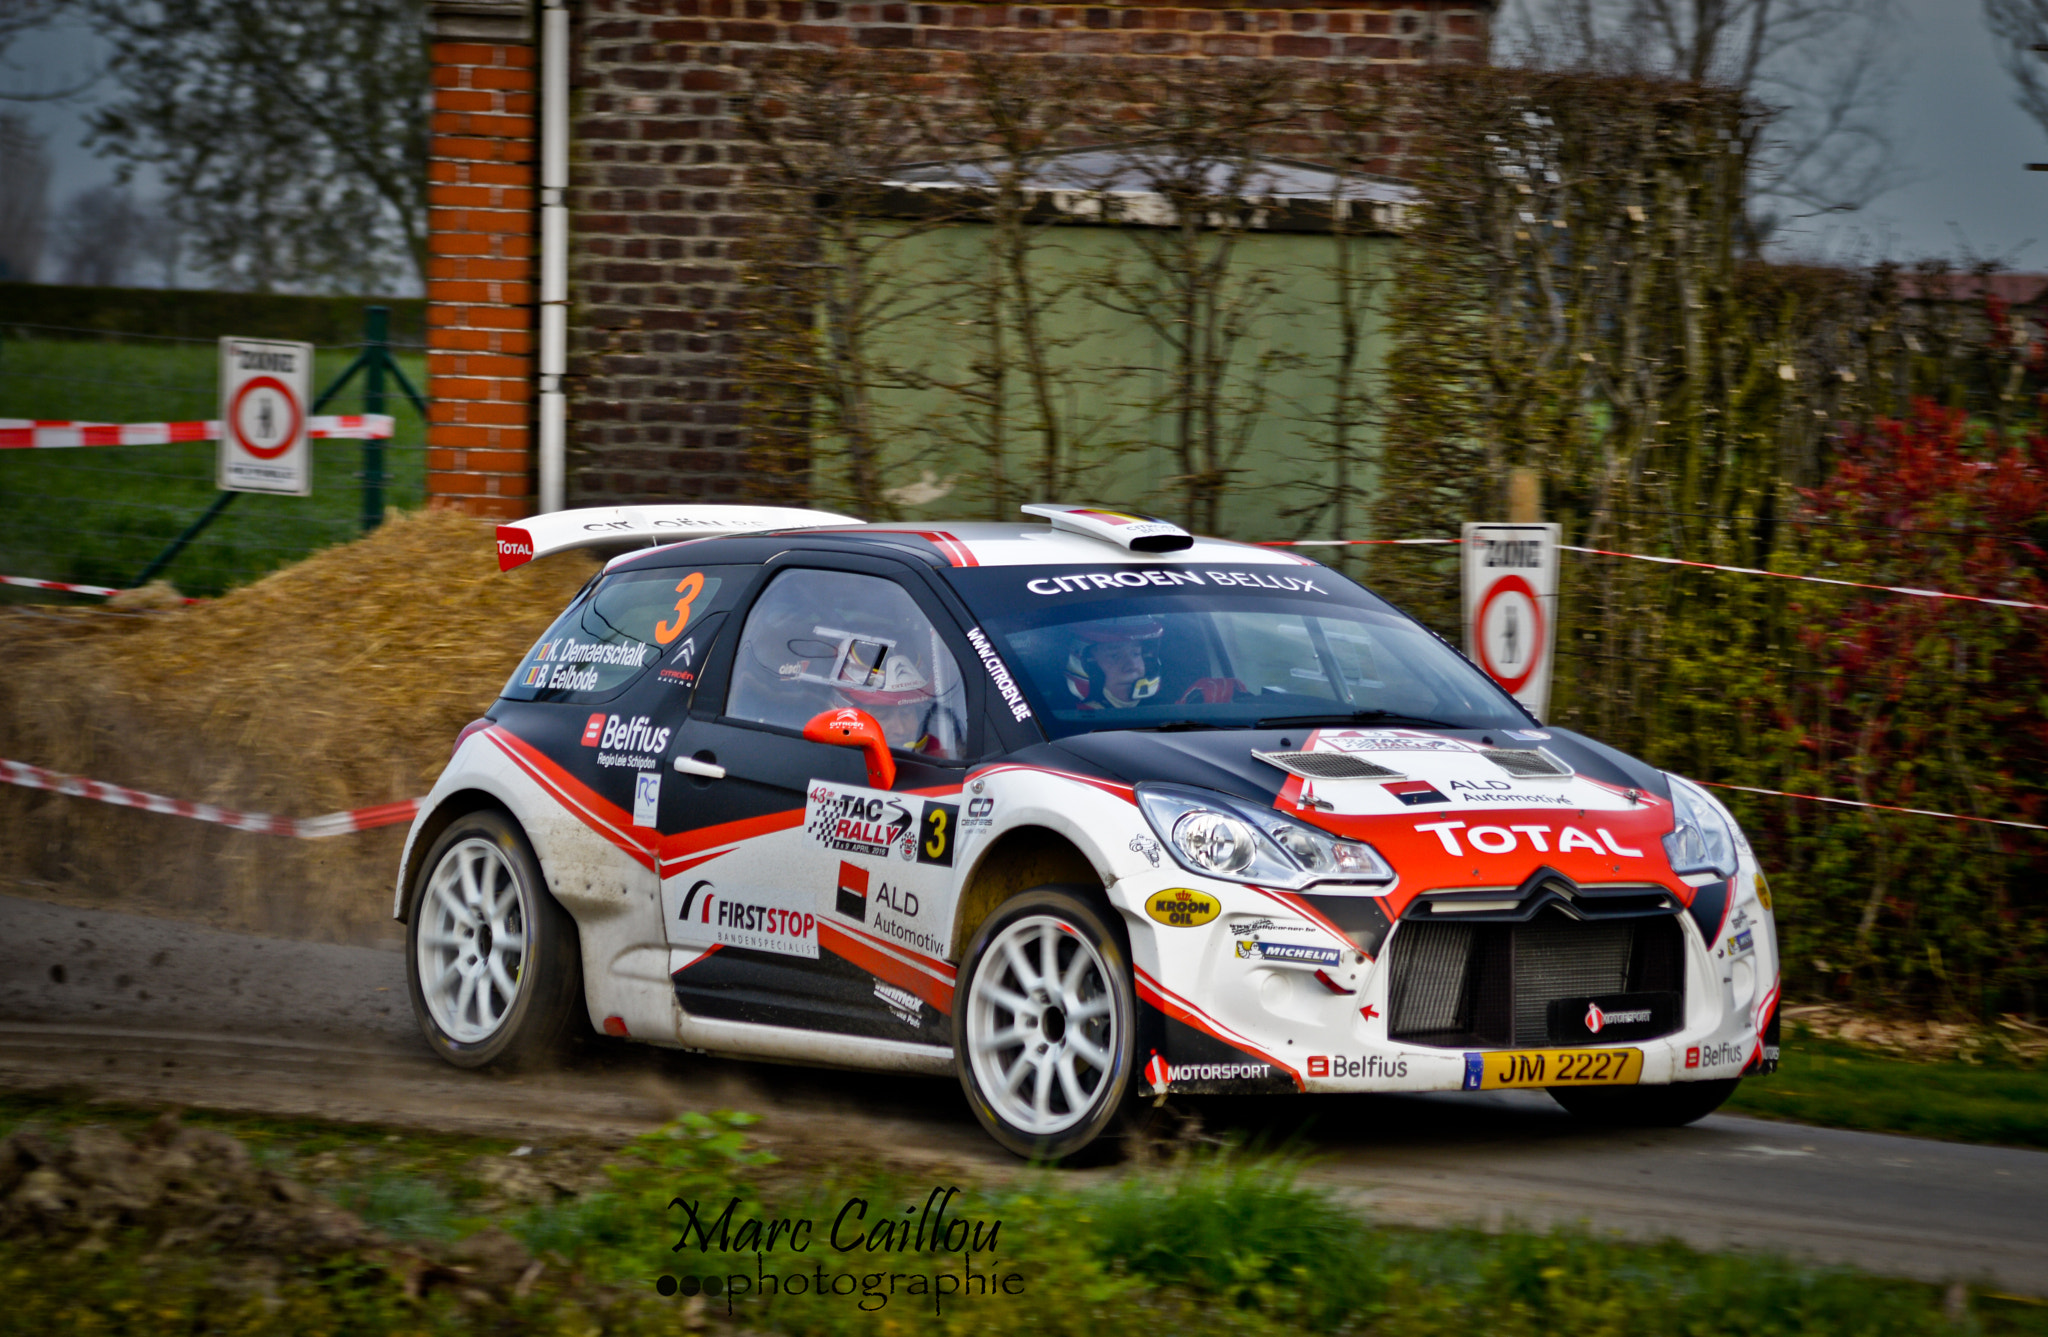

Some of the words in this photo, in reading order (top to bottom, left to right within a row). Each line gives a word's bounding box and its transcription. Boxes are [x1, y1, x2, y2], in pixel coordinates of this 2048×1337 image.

[497, 540, 532, 555] TOTAL
[1027, 570, 1206, 595] CITROEN
[1205, 570, 1329, 595] BELUX
[654, 572, 705, 645] 3
[544, 638, 562, 661] K.
[559, 638, 648, 667] Demaerschalk
[534, 664, 549, 688] B.
[549, 666, 599, 691] Eelbode
[601, 714, 671, 753] Belfius
[1450, 780, 1511, 790] ALD
[841, 794, 883, 822] TAC
[1463, 793, 1574, 806] Automotive
[835, 819, 899, 845] RALLY
[926, 809, 947, 858] 3
[1414, 821, 1643, 857] TOTAL
[852, 844, 869, 853] APRIL
[876, 882, 919, 917] ALD
[1156, 901, 1210, 914] KROON
[1169, 913, 1192, 924] OIL
[718, 932, 817, 955] BANDENSPECIALIST
[1266, 947, 1338, 961] MICHELIN
[1604, 1010, 1651, 1024] MOTORSPORT
[1334, 1055, 1408, 1078] Belfius
[1702, 1042, 1742, 1067] Belfius
[1168, 1063, 1271, 1080] MOTORSPORT
[1470, 1075, 1477, 1087] L
[1499, 1054, 1545, 1083] JM
[1555, 1053, 1629, 1081] 2227
